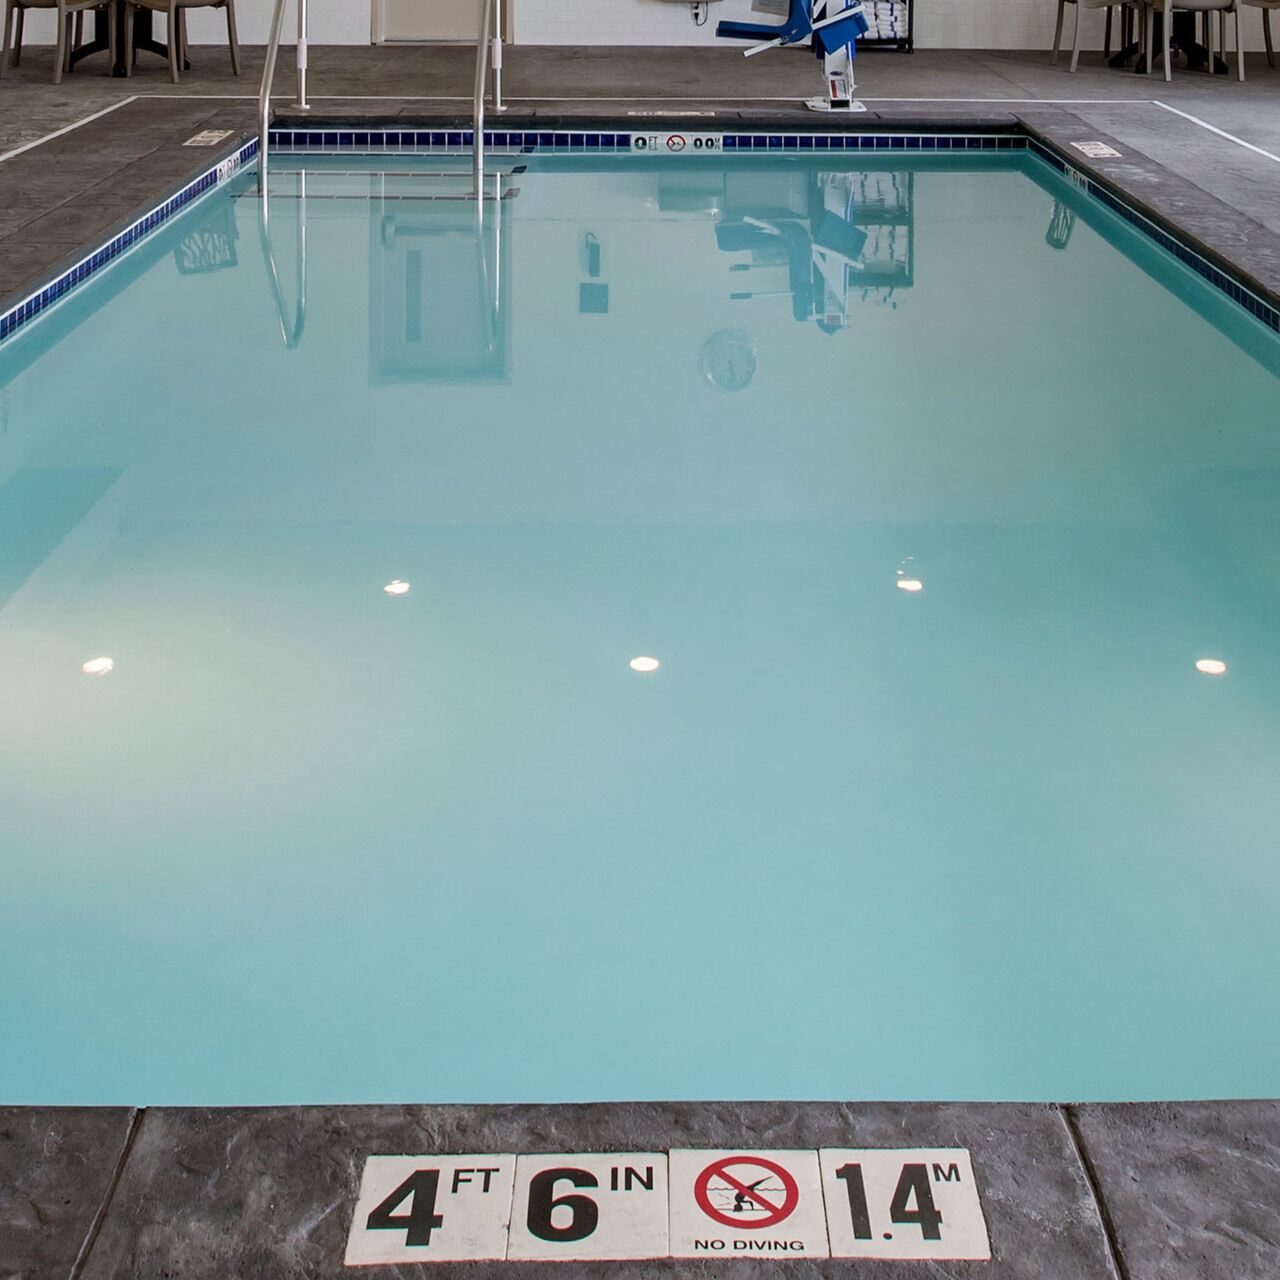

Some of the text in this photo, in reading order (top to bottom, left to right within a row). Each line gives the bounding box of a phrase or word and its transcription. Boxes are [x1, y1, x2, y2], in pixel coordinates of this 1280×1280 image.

[365, 1168, 444, 1247] 4
[451, 1167, 500, 1194] FT
[525, 1167, 600, 1243] 6
[610, 1166, 655, 1192] IN
[835, 1163, 943, 1241] 1.4
[694, 1238, 805, 1252] NO DIVING
